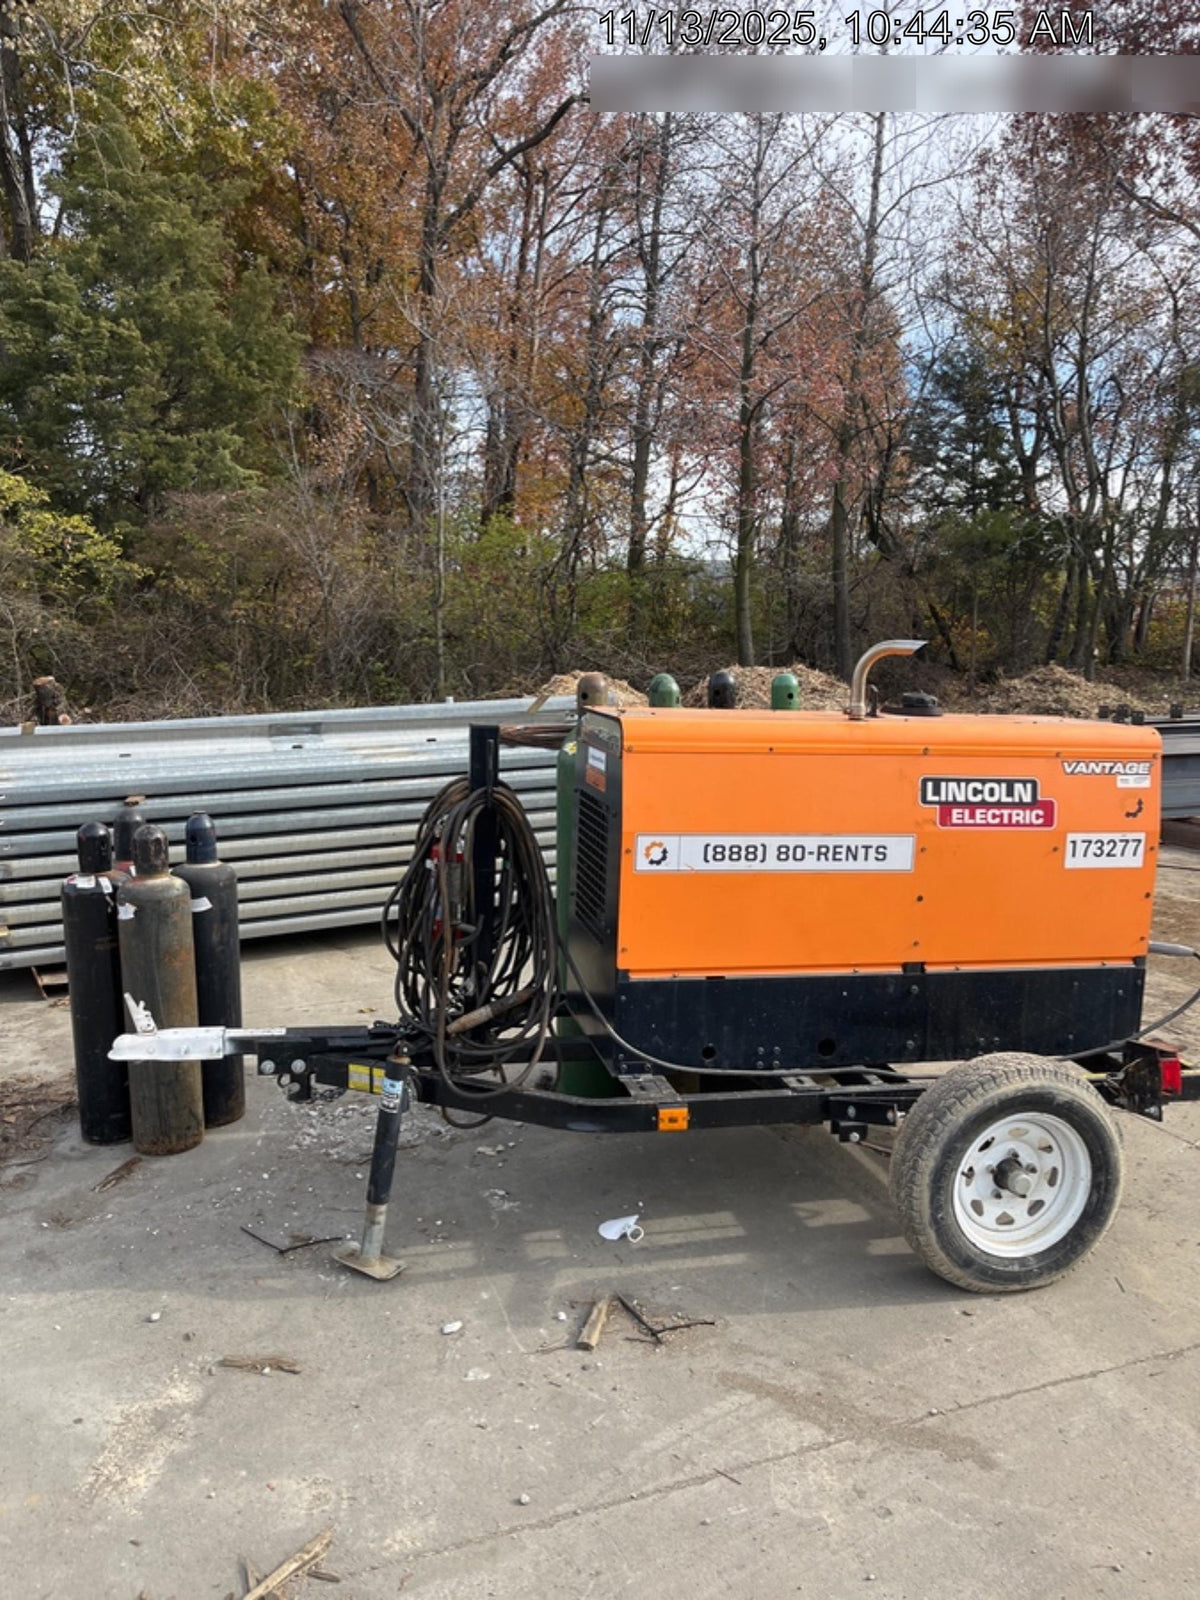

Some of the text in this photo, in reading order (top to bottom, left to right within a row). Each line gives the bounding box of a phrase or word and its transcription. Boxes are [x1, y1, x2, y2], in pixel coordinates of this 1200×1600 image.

[1062, 761, 1152, 775] VANTAGE
[925, 781, 1033, 803] LINCOLN
[951, 808, 1045, 825] ELECTRIC
[703, 843, 888, 863] (888) 80-RENTS
[1069, 838, 1143, 858] 173277
